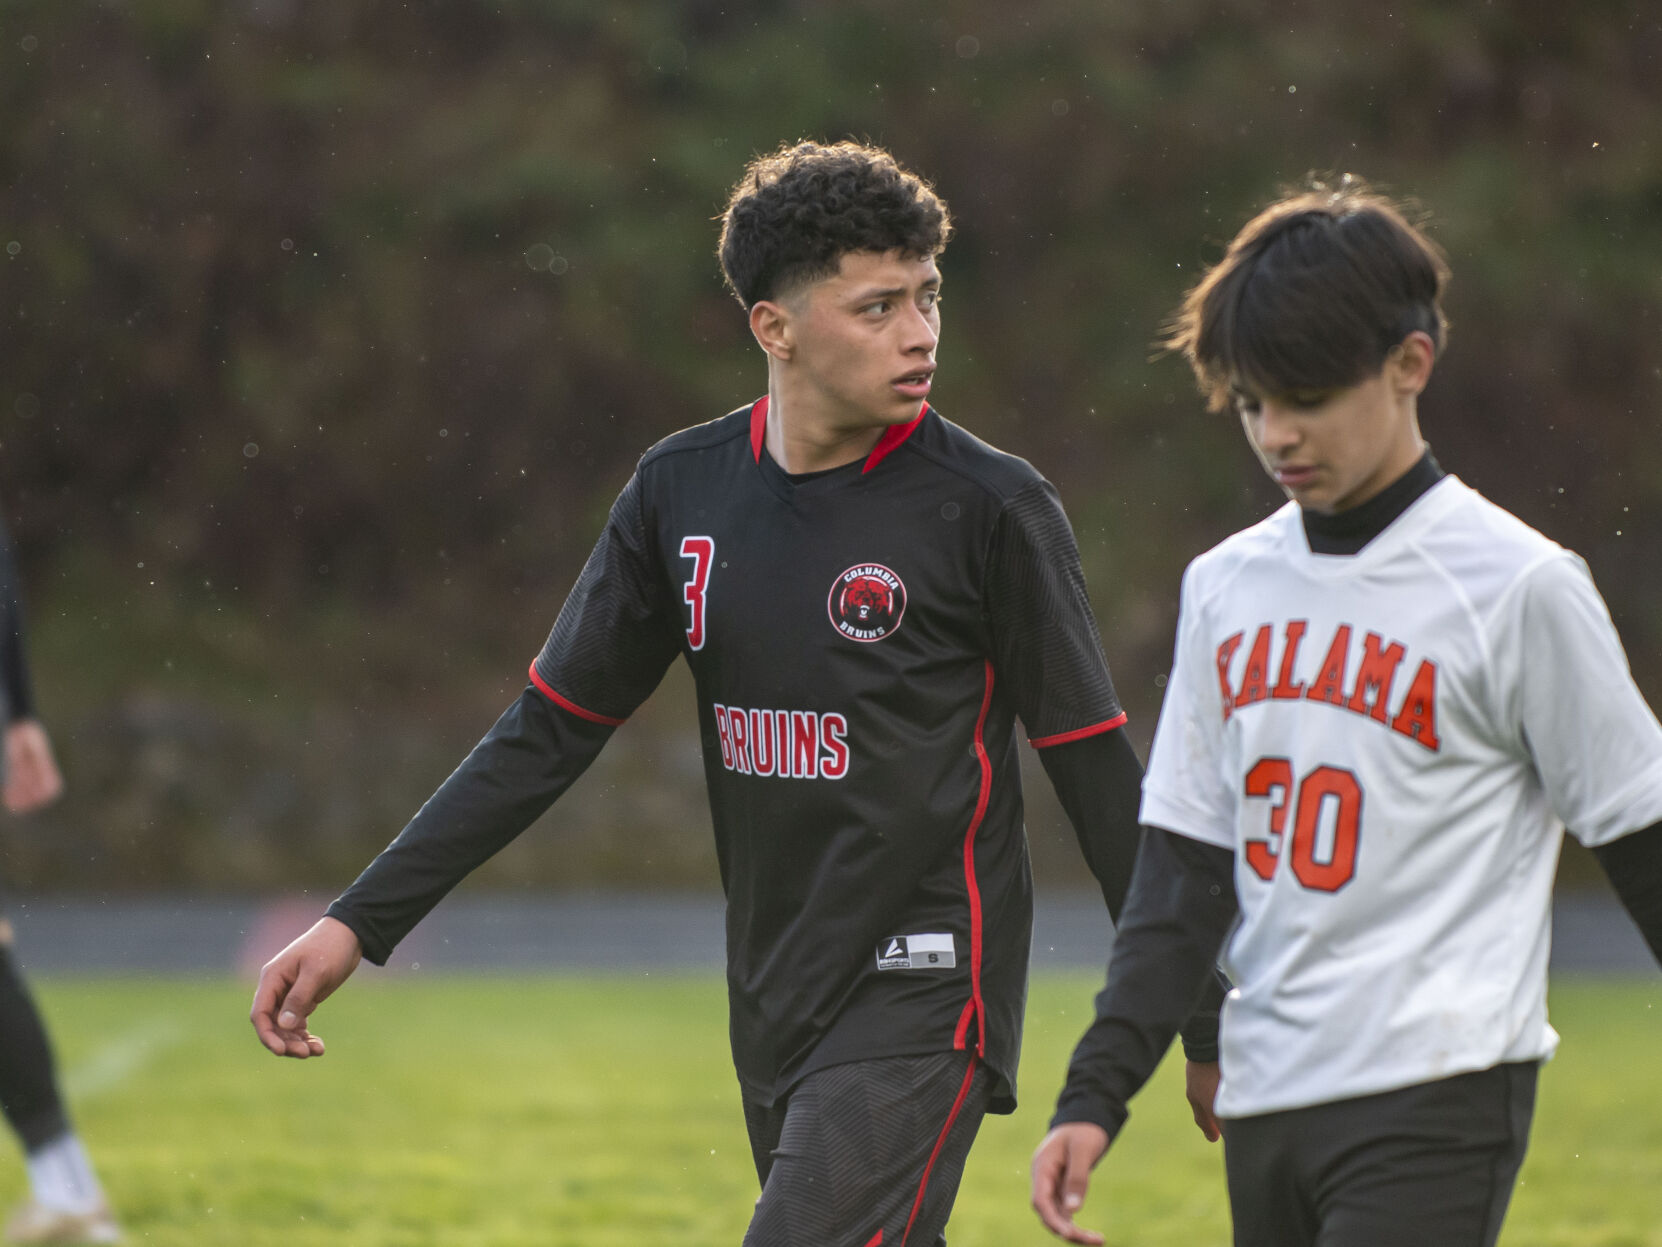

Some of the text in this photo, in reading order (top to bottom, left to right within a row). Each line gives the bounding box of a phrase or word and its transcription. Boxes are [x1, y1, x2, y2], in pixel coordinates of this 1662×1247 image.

[680, 536, 714, 651] 3
[843, 566, 899, 590] COLUMBIA
[839, 621, 885, 638] BRUINS
[713, 702, 850, 780] BRUINS
[1243, 756, 1364, 895] 30
[928, 953, 939, 963] S
